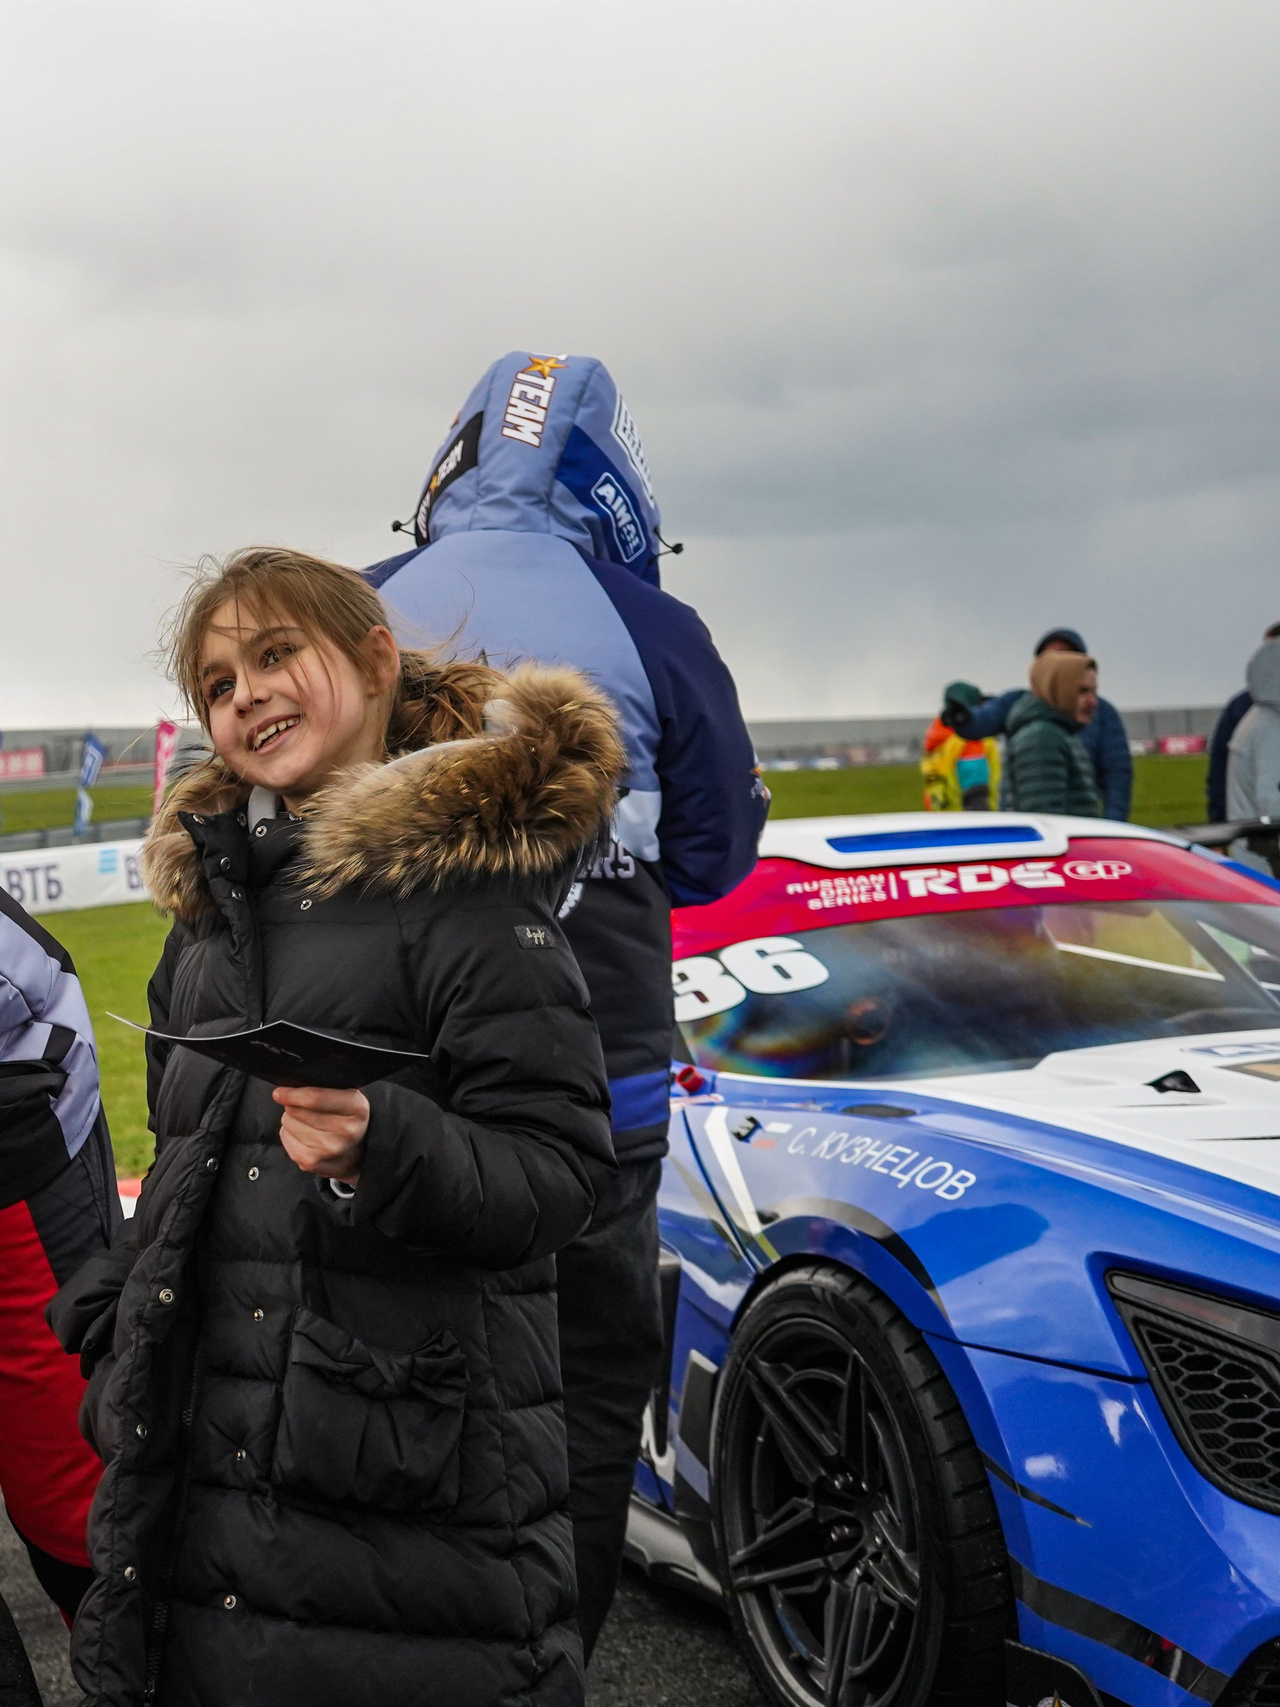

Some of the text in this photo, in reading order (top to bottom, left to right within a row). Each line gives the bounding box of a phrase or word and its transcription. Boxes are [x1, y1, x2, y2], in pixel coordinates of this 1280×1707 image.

[501, 371, 556, 448] TEAM
[6, 863, 62, 903] ВТБ
[786, 873, 885, 895] RUSSIAN
[900, 860, 1133, 898] RDS GP
[807, 891, 887, 910] SERIES
[671, 935, 830, 1022] 36
[812, 1130, 977, 1201] КУЗНЕЦОВ
